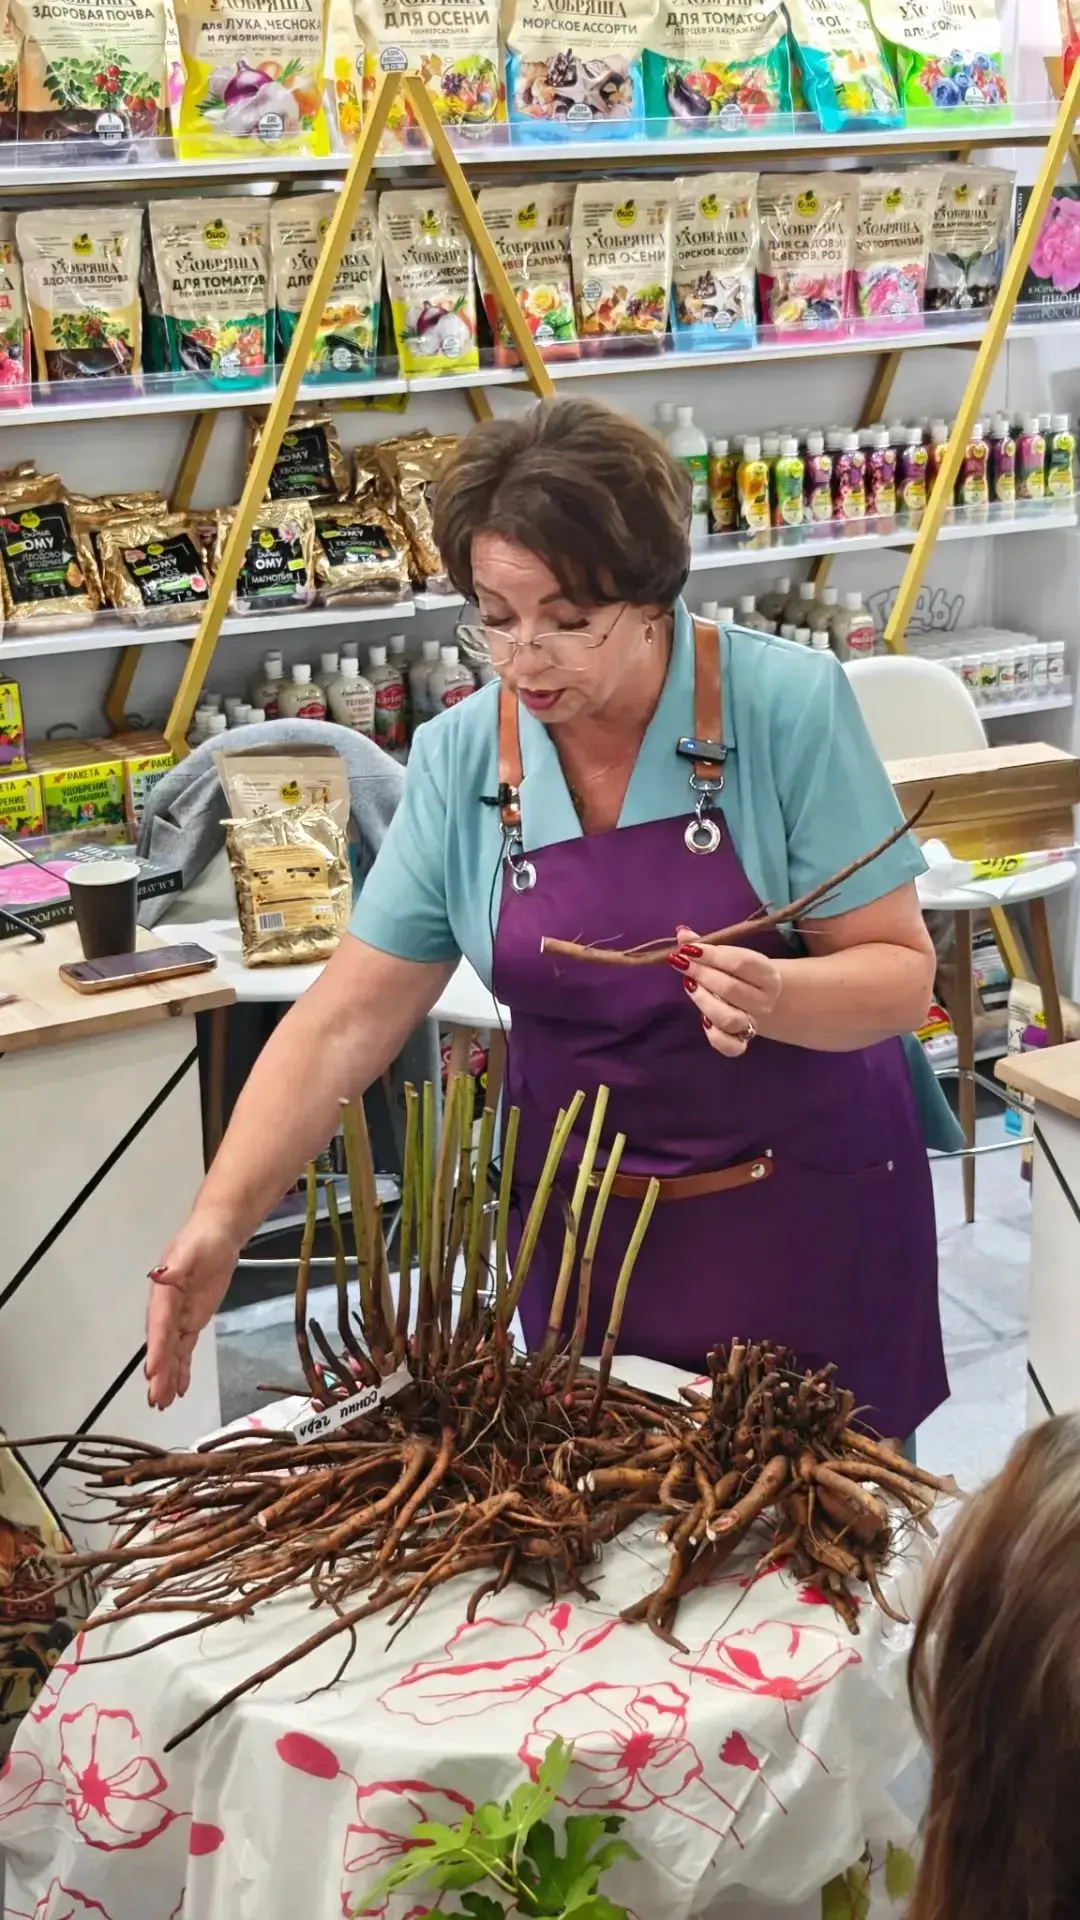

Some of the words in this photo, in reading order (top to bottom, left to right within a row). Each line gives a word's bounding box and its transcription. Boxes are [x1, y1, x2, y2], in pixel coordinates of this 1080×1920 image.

[32, 6, 104, 20] ЗДОРОВАЯ
[107, 7, 155, 21] ПОЧВА
[384, 11, 423, 29] ДЛЯ
[428, 10, 490, 27] ОСЕНИ
[666, 12, 700, 28] ДЛЯ
[702, 11, 772, 26] ТОМАТО
[522, 17, 580, 32] МОРСКОЕ
[583, 22, 638, 34] АССОРТИ
[617, 208, 634, 218] био
[206, 230, 226, 239] био
[588, 252, 616, 267] ДЛЯ
[173, 277, 201, 291] ДЛЯ
[202, 274, 266, 289] ТОМАТОВ
[67, 768, 100, 780] РАКЕТА
[0, 781, 16, 793] ЕТА
[62, 780, 109, 796] УДОБРЕНИЕ
[282, 788, 299, 796] био
[0, 795, 25, 808] РЕНИЕ
